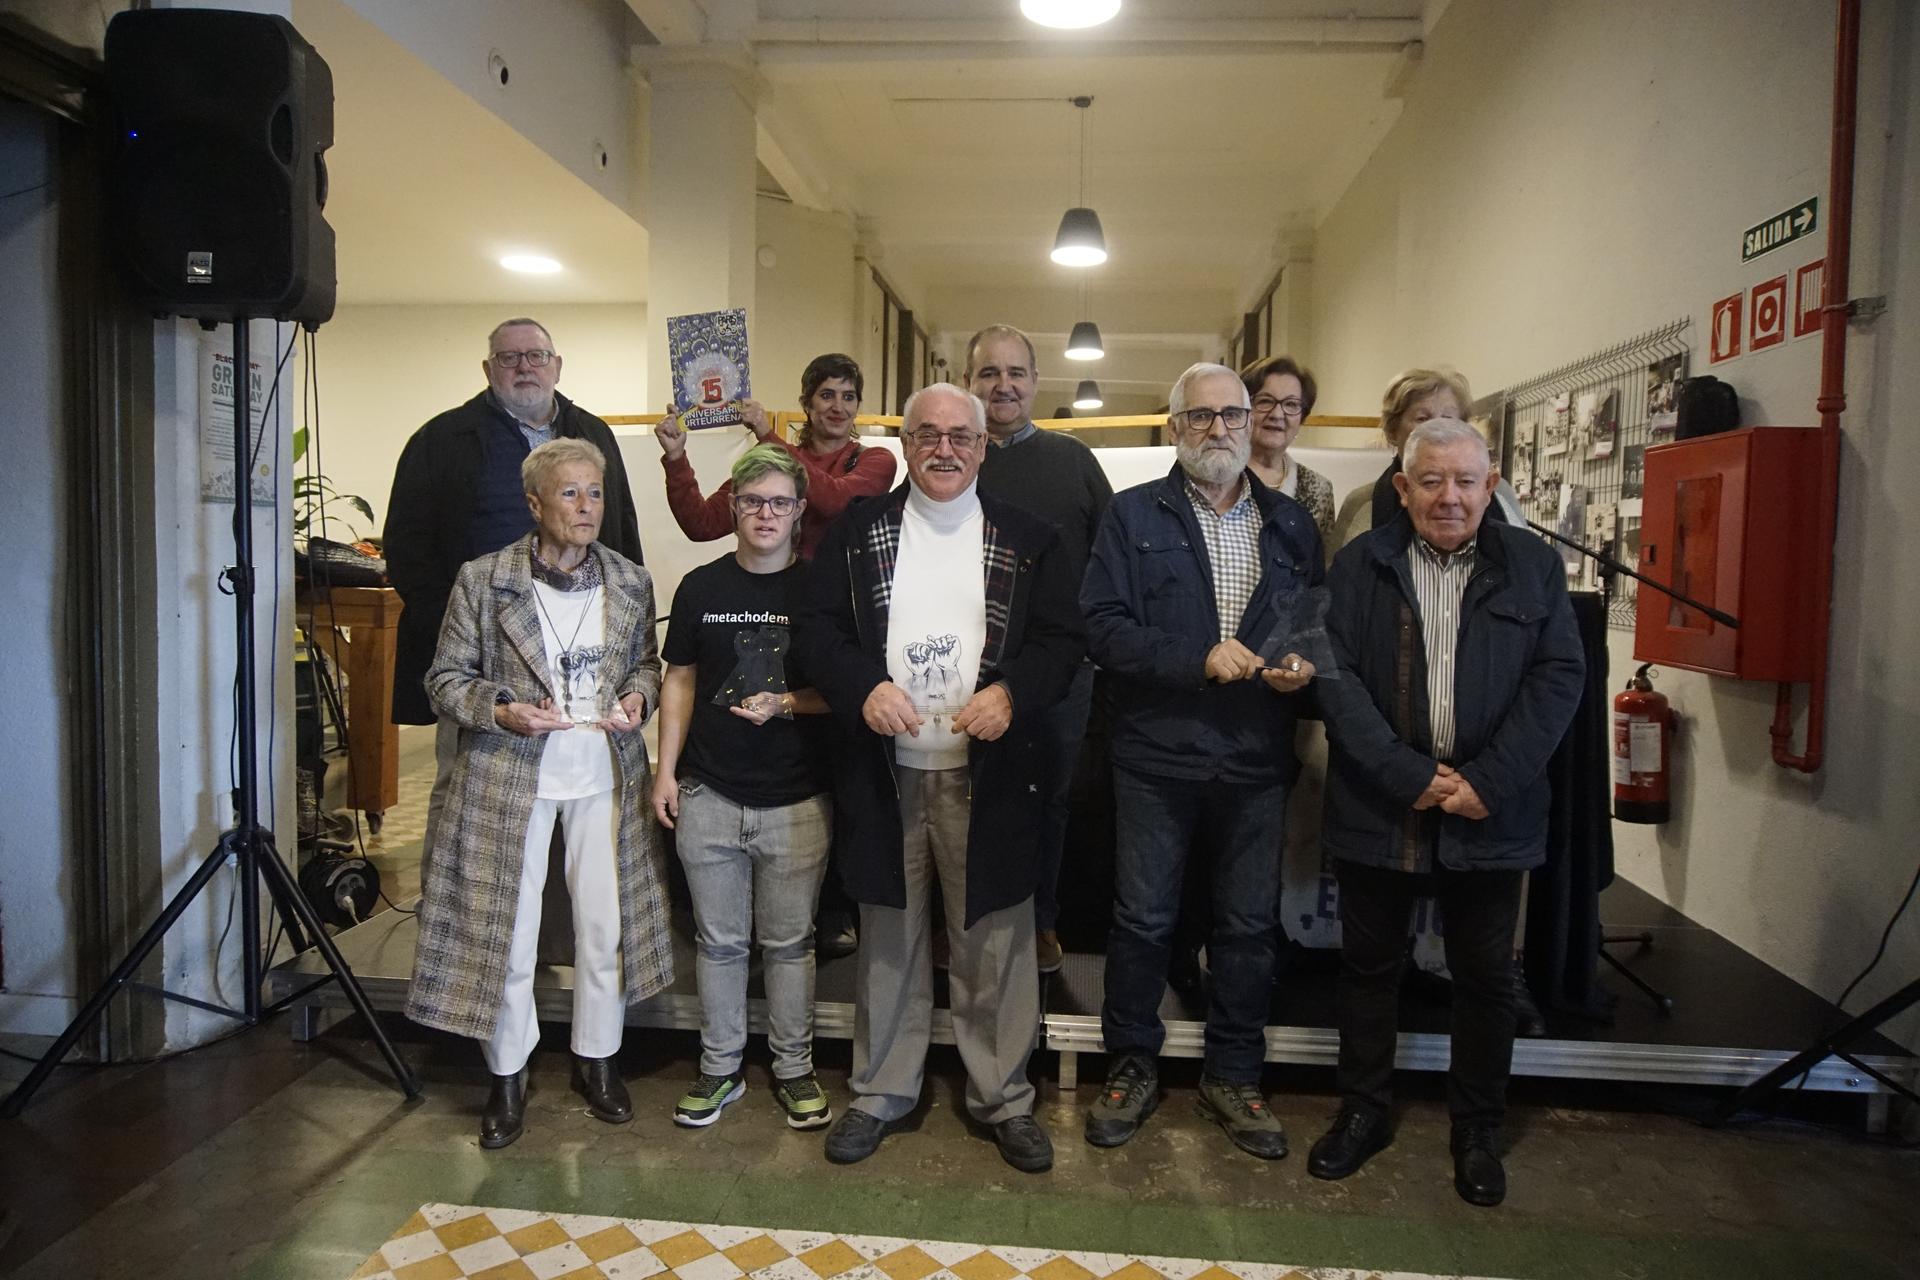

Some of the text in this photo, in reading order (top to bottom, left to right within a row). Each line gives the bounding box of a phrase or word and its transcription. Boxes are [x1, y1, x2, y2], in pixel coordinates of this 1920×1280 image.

[1745, 215, 1792, 257] SALIDA
[212, 363, 262, 391] GRN
[701, 378, 722, 401] 15
